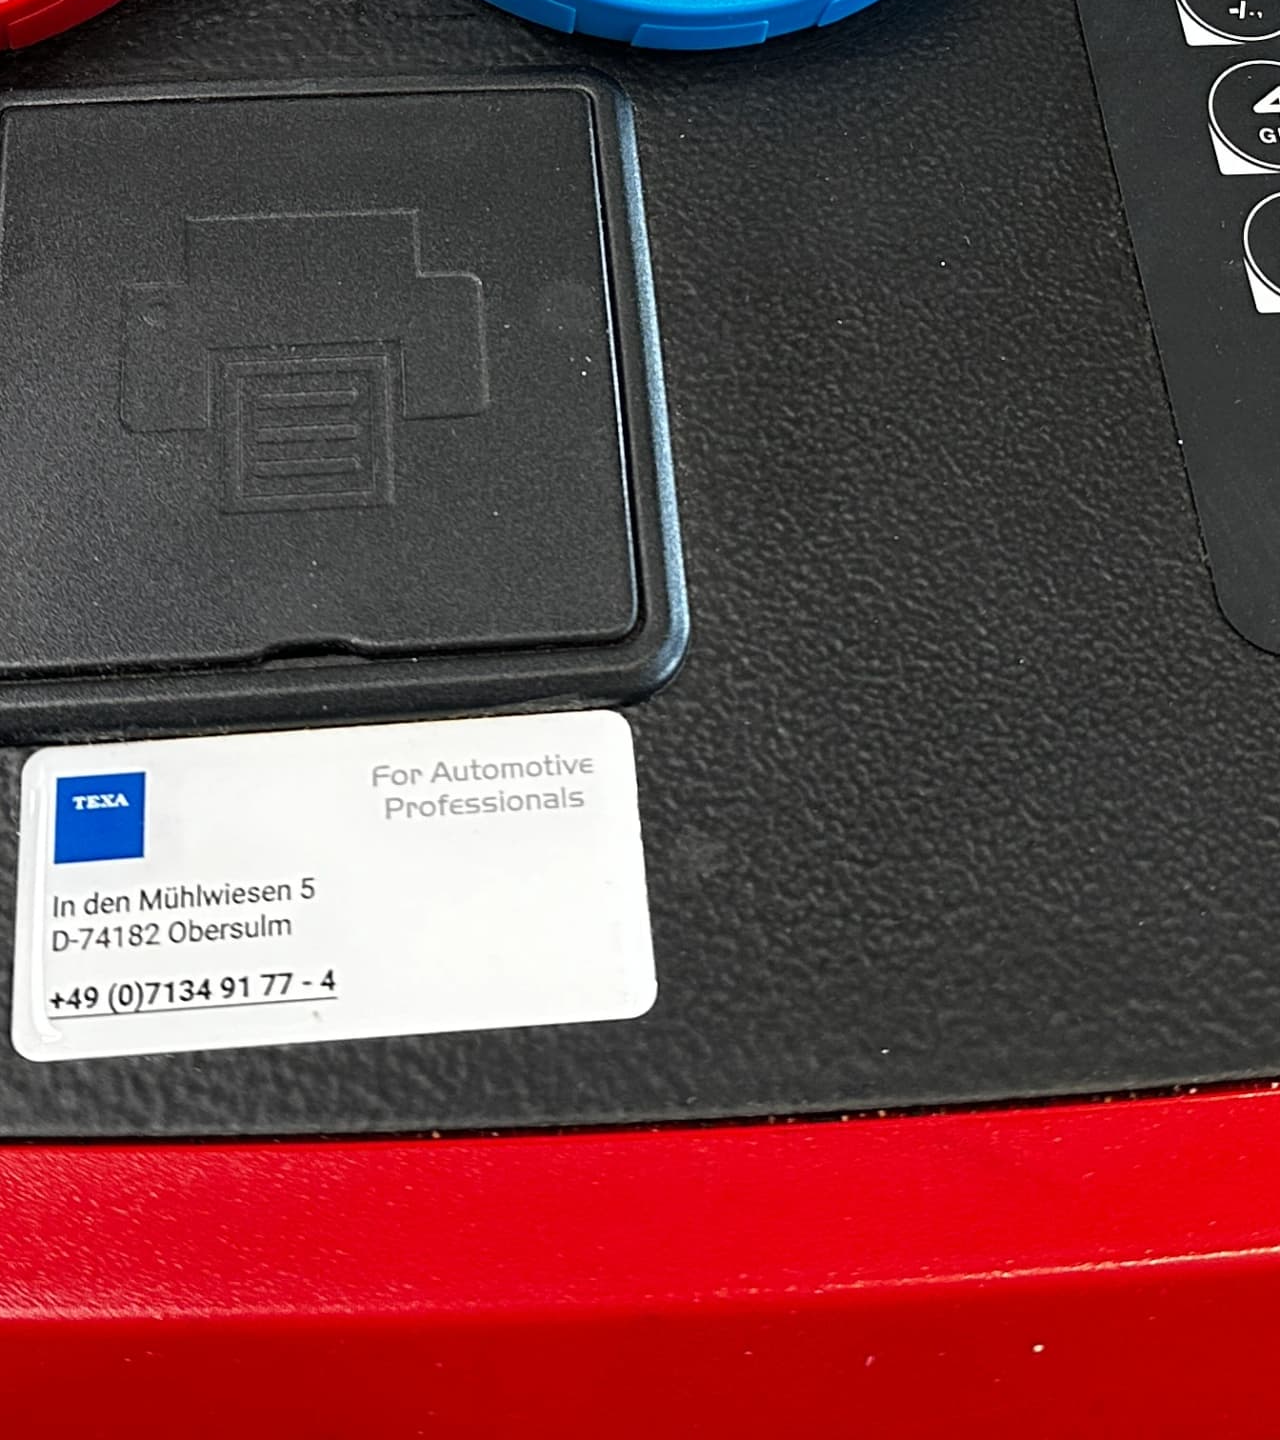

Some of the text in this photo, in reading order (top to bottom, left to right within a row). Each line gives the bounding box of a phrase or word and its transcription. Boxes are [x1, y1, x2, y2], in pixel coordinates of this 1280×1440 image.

[372, 754, 594, 787] For Automotive
[72, 792, 130, 811] TEXA
[385, 786, 585, 820] Professionals
[52, 877, 316, 918] In den Mühlwiesen 5
[51, 914, 292, 952] D-74182 Obersulm
[49, 986, 99, 1010] +49
[108, 978, 212, 1014] (0)7134
[220, 976, 249, 999] 91
[260, 972, 294, 996] 77
[320, 969, 336, 991] 4
